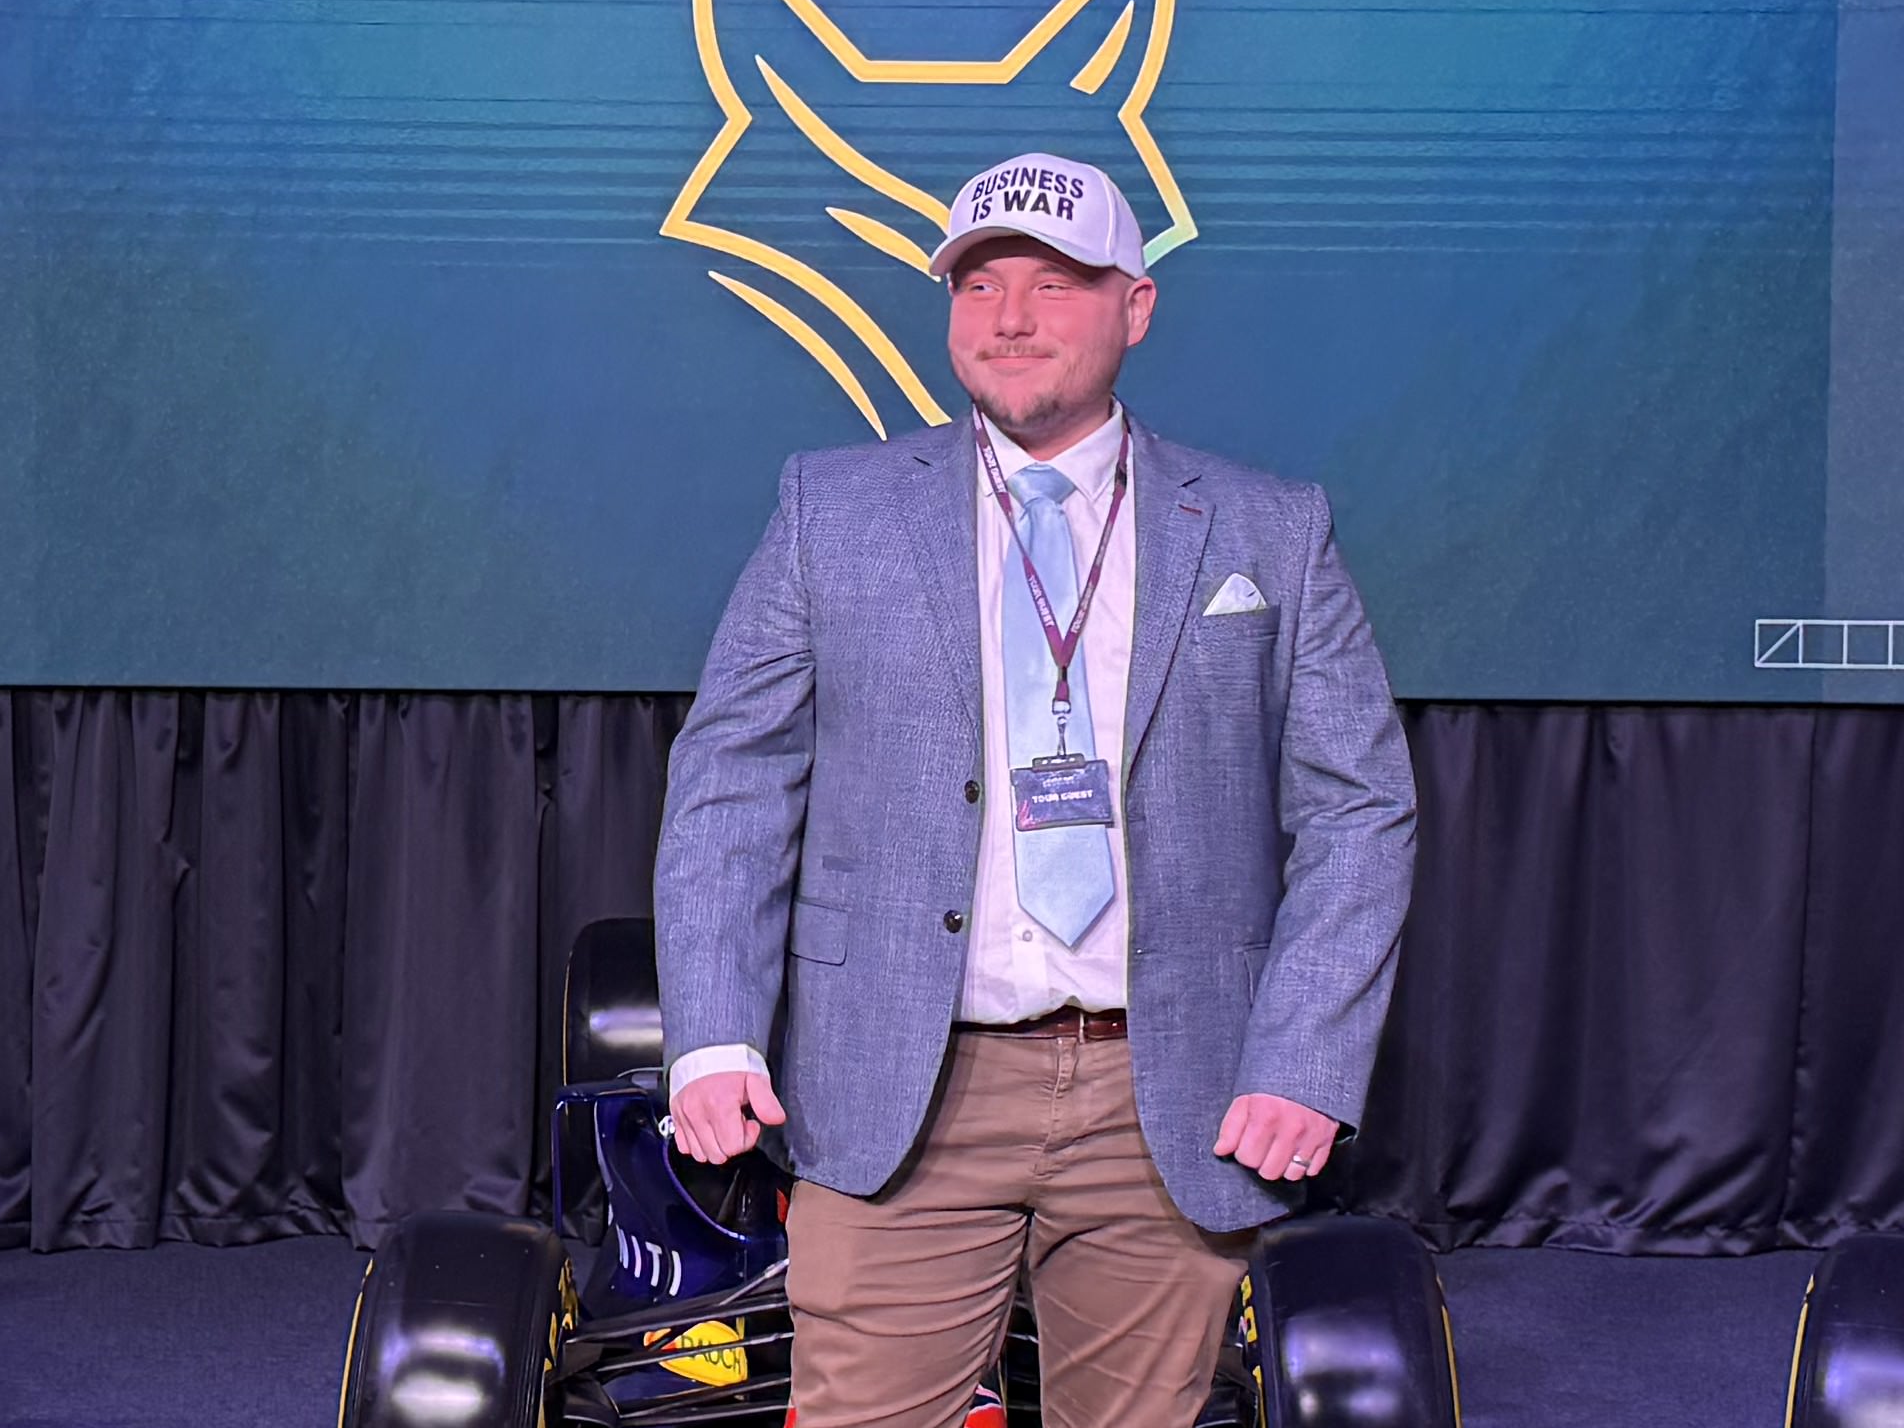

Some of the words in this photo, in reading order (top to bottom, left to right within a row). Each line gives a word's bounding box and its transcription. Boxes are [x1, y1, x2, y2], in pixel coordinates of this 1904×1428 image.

[971, 167, 1084, 202] BUSINESS
[972, 197, 993, 223] IS
[1004, 189, 1075, 221] WAR
